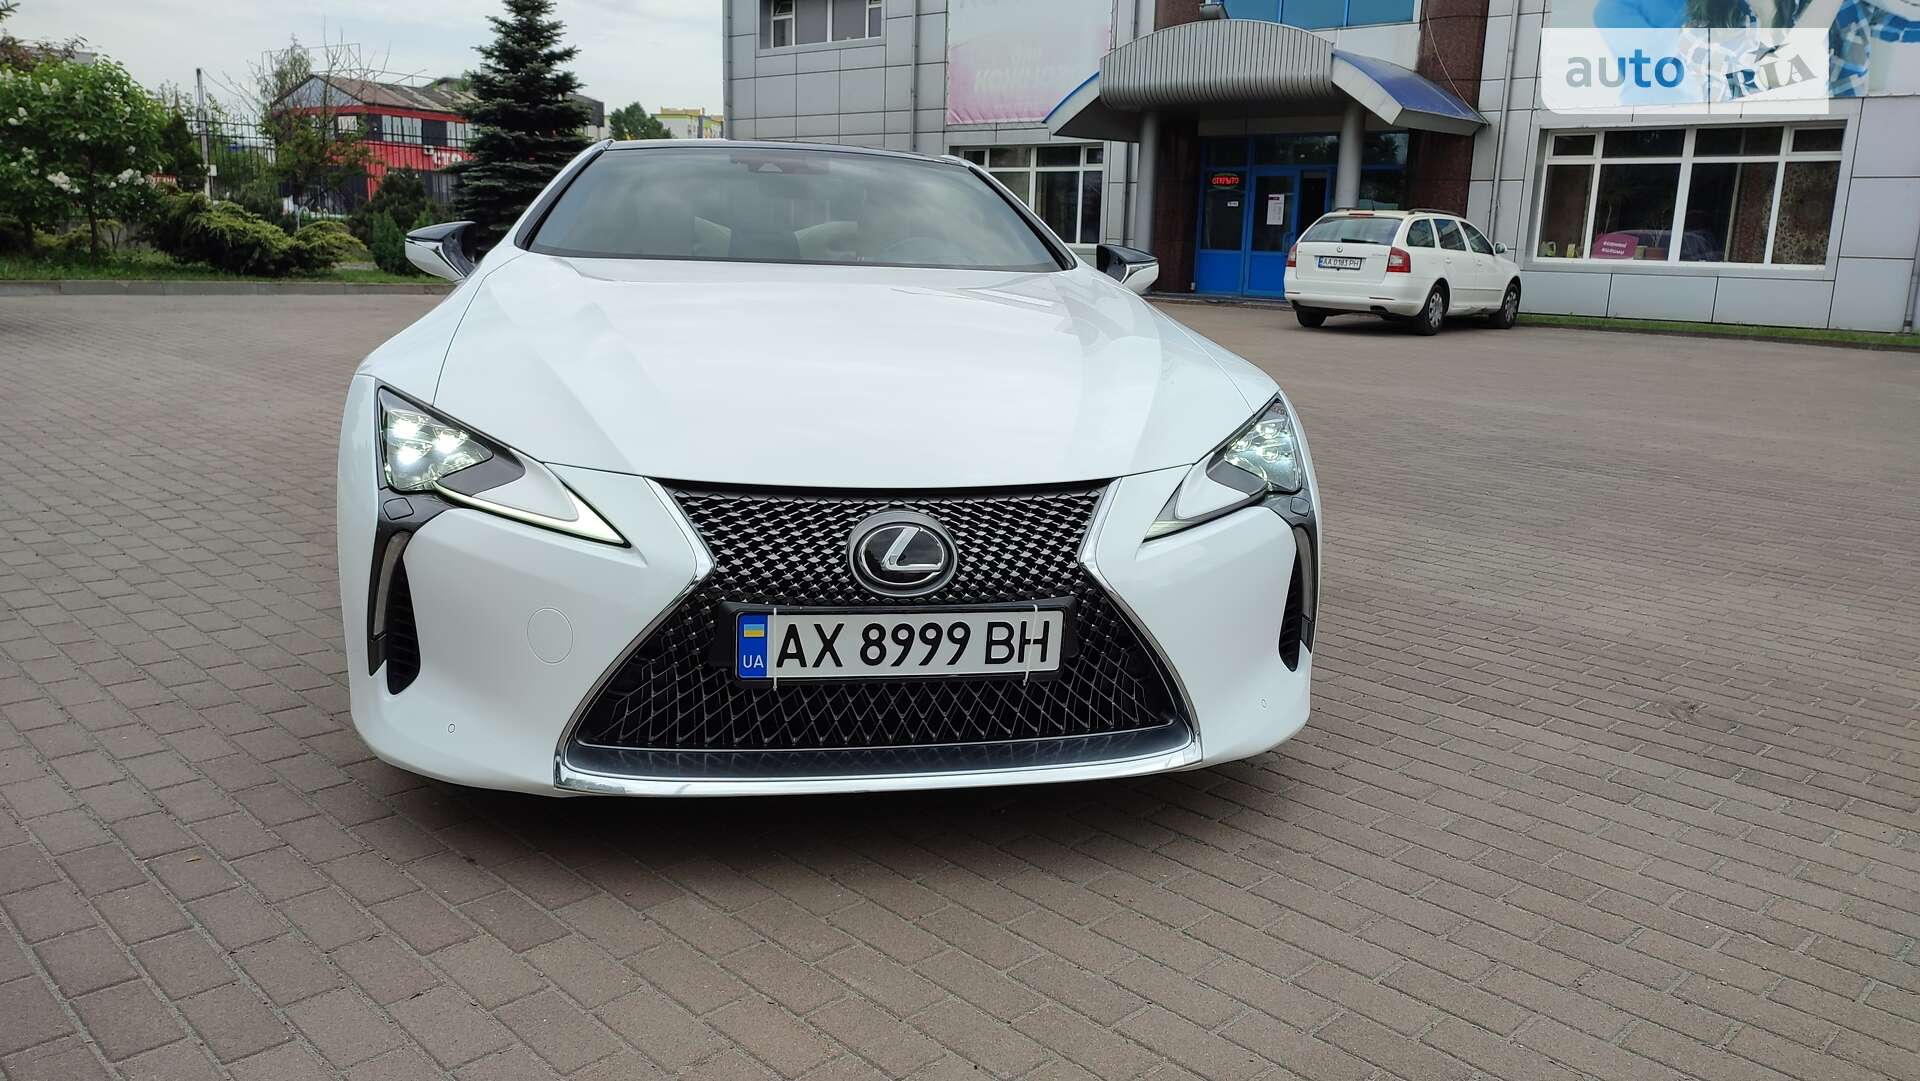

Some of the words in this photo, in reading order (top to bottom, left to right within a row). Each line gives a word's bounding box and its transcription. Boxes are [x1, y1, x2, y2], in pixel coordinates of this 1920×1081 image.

[776, 623, 845, 668] AX
[859, 621, 971, 667] 8999
[984, 620, 1050, 665] BH
[742, 655, 765, 669] UA
